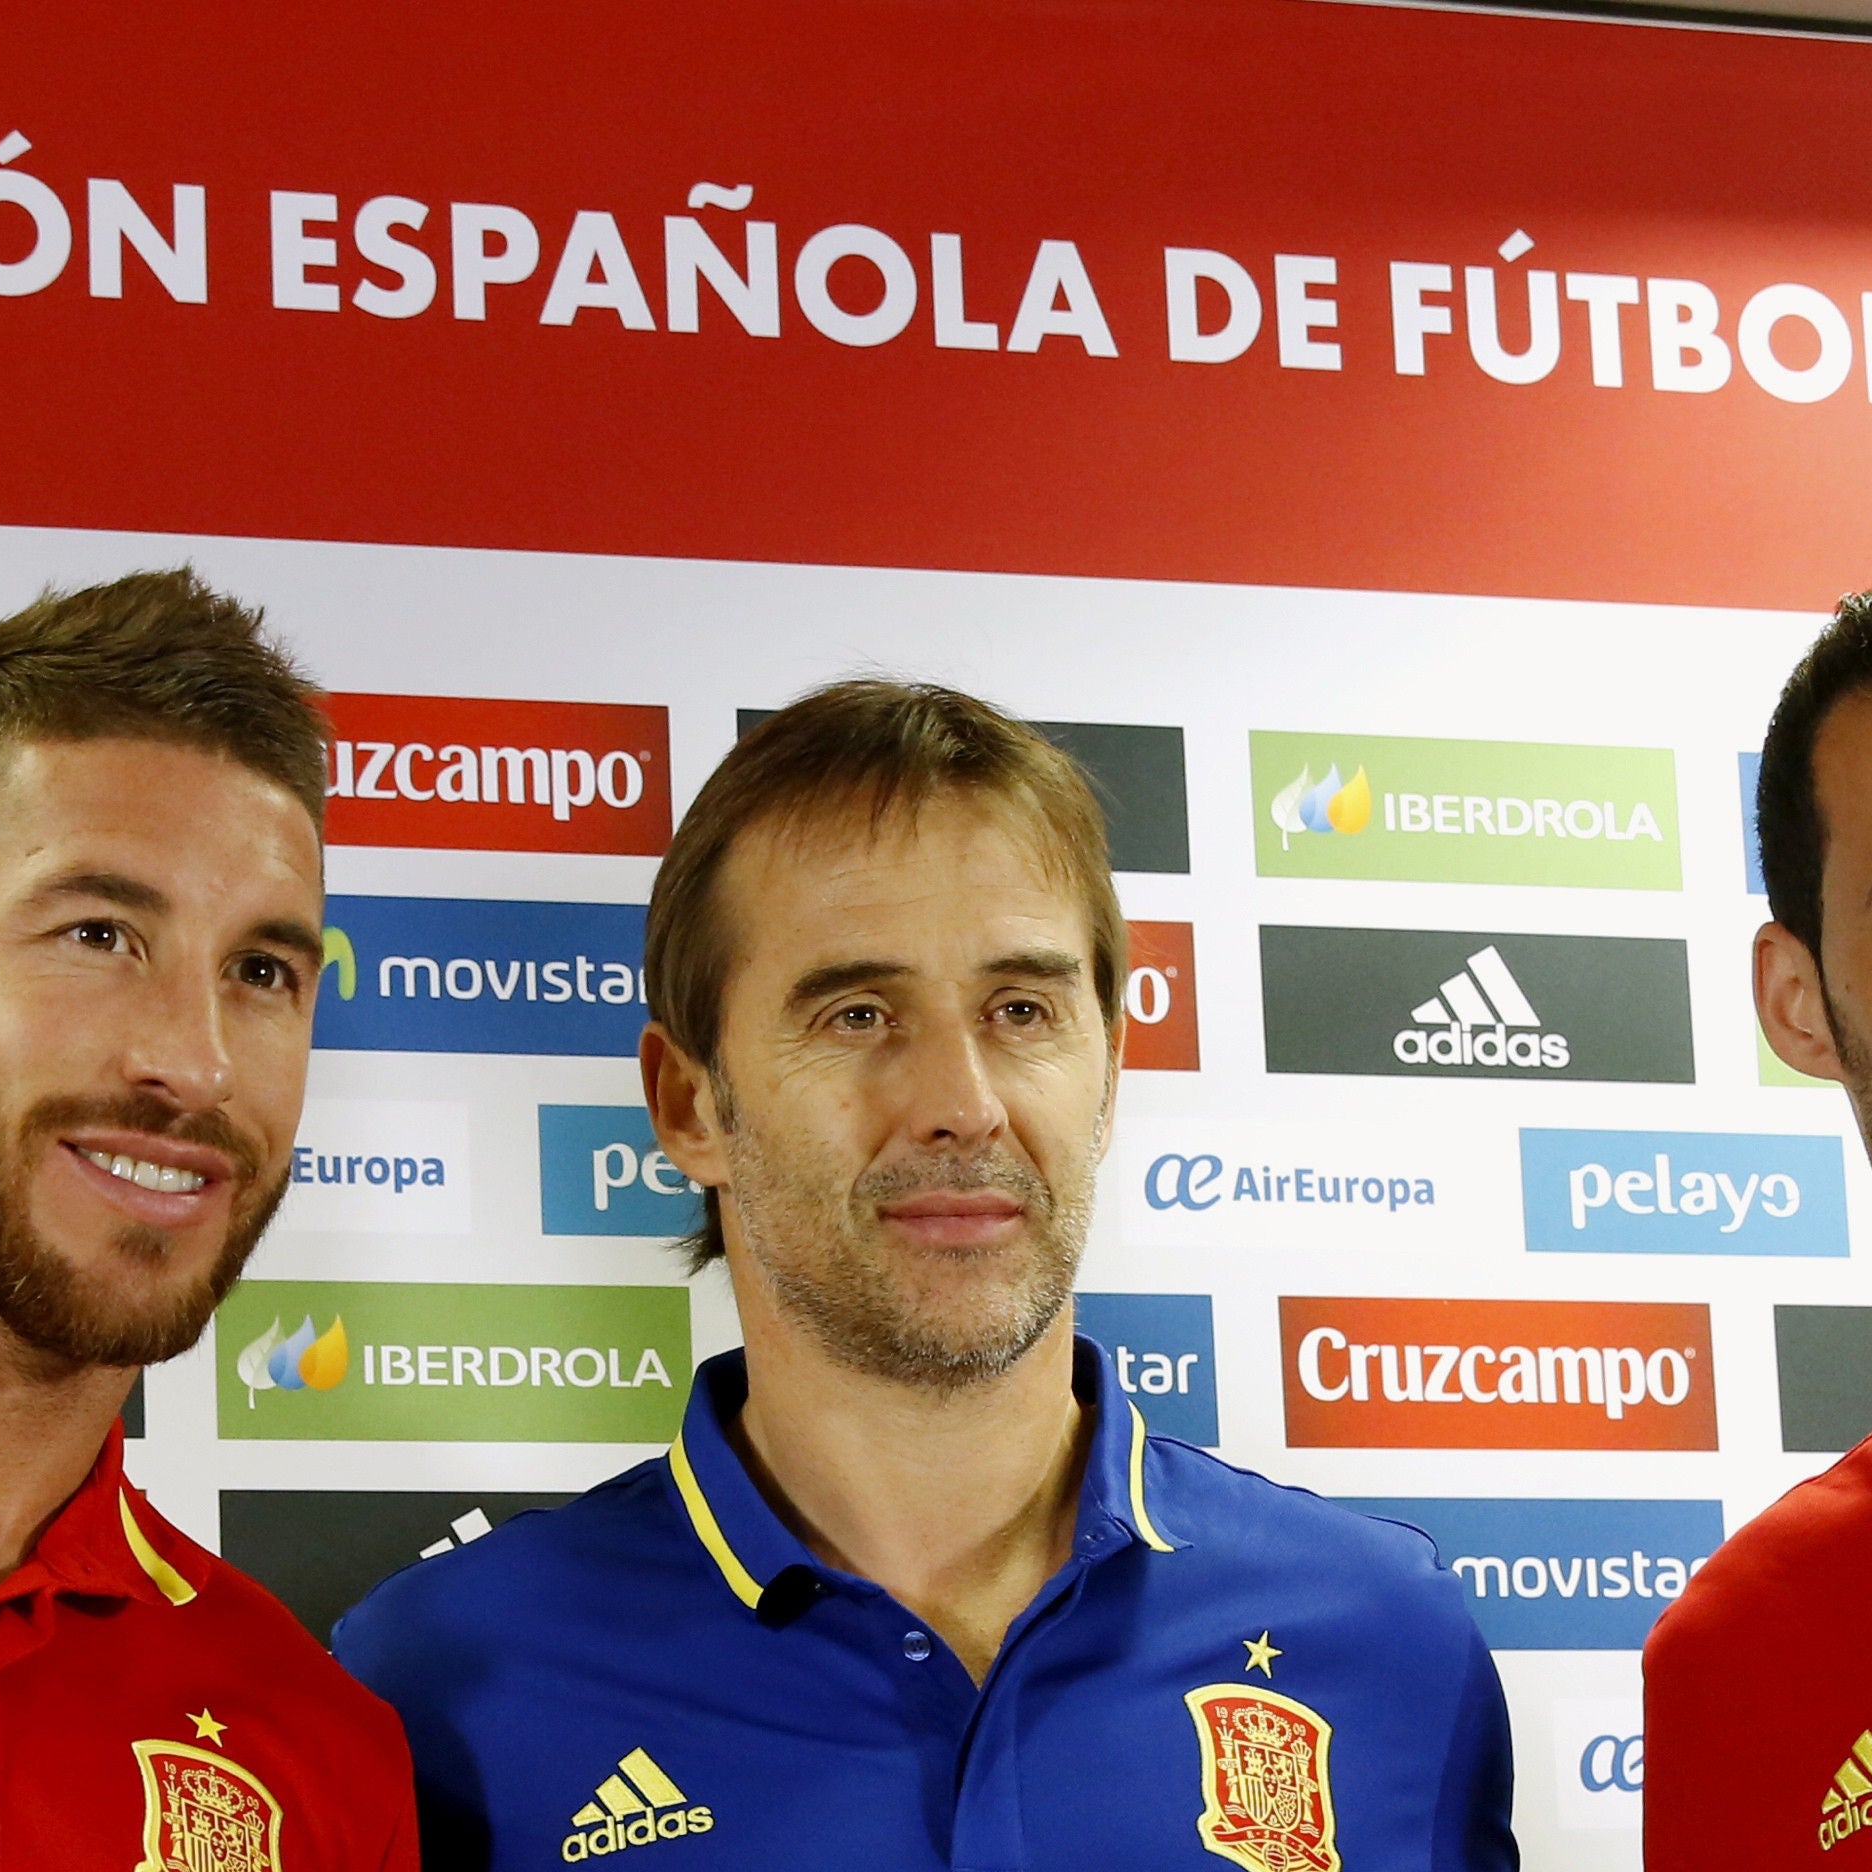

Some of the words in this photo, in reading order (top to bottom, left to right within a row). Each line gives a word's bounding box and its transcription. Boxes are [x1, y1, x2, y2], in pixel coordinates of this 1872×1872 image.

[271, 183, 1118, 357] ESPAÑOLA
[1165, 248, 1342, 370] DE
[327, 737, 643, 821] uzcampo
[1384, 793, 1662, 842] IBERDROLA
[1394, 1023, 1570, 1069] adidas
[291, 1146, 445, 1195] Europa
[1233, 1166, 1435, 1212] AirEuropa
[1571, 1155, 1800, 1233] pelayo
[363, 1345, 672, 1388] IBERDROLA
[1298, 1328, 1688, 1419] Cruzcampo
[1453, 1552, 1697, 1600] movista
[561, 1800, 713, 1864] adidas
